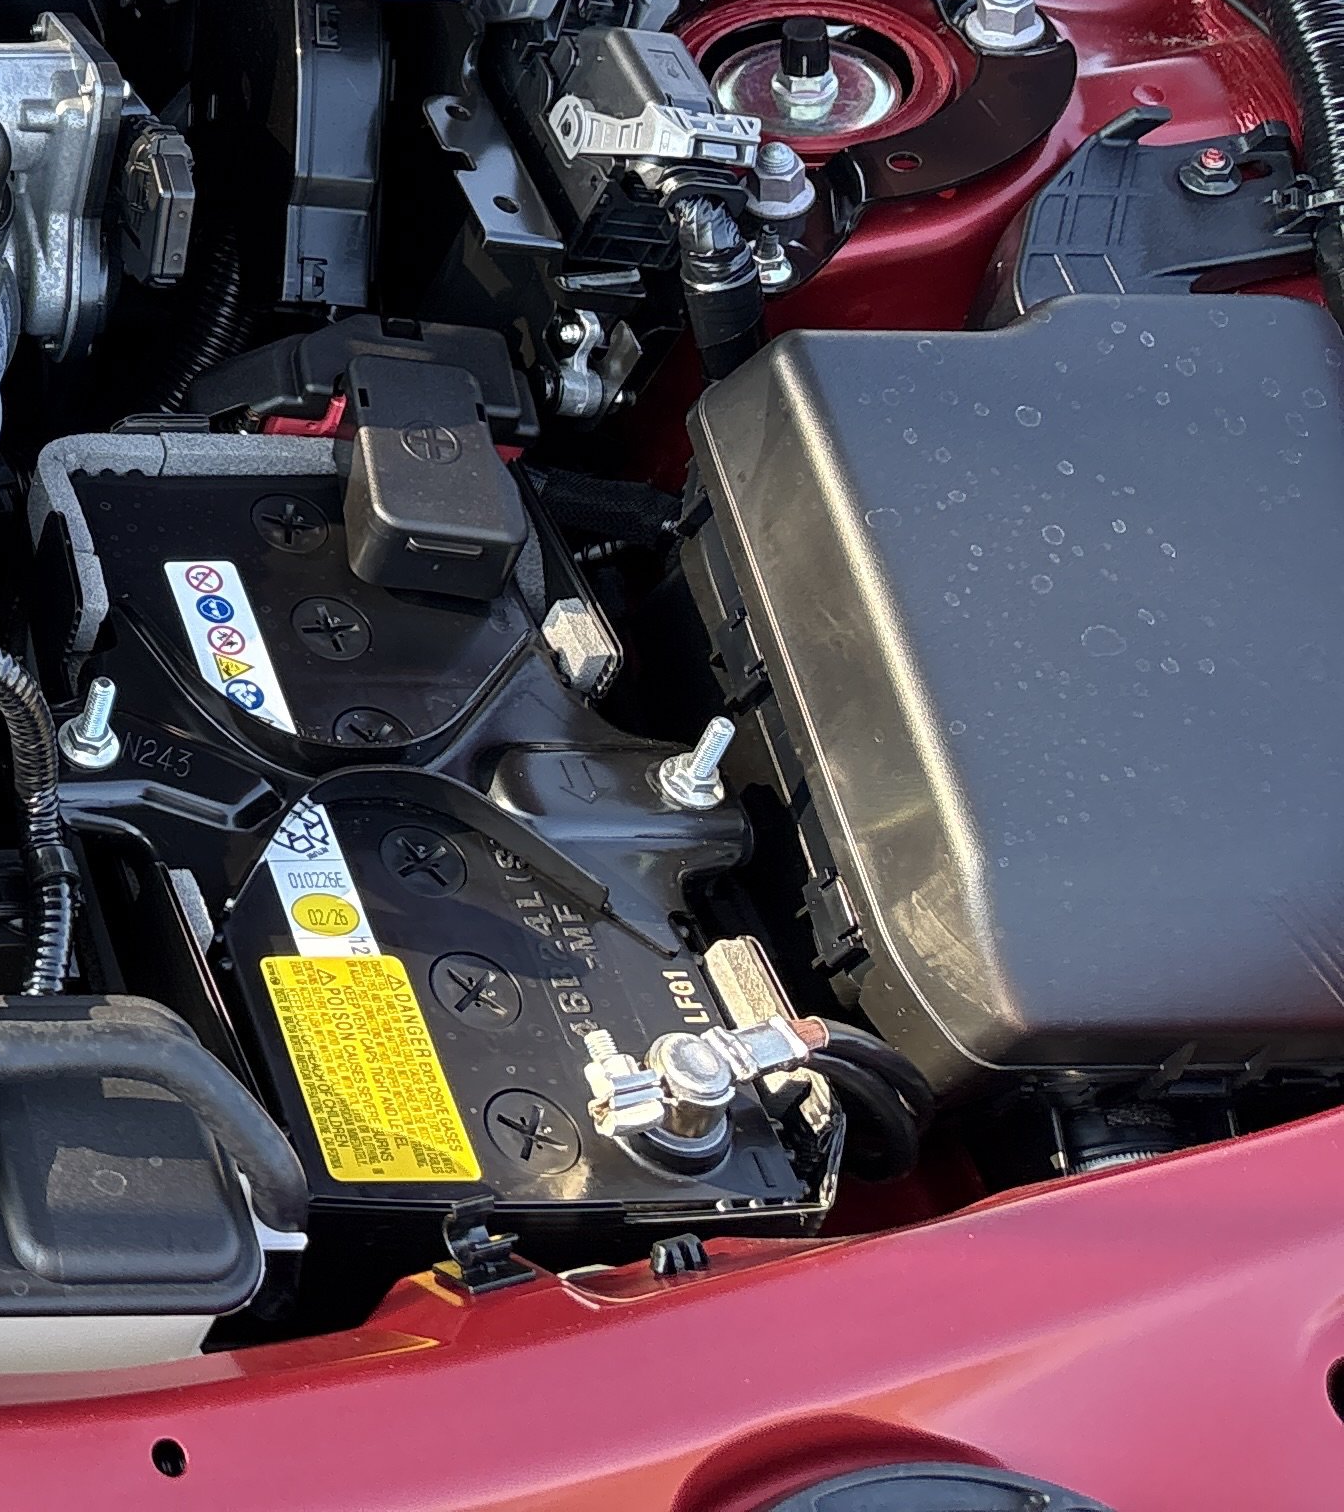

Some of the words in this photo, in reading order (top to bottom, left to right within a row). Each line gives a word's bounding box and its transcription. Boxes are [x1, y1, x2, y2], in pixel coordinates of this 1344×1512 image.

[121, 731, 194, 778] N243
[287, 871, 347, 889] 010226E
[307, 908, 349, 927] 02/26
[284, 987, 303, 1010] KEEP
[341, 985, 360, 1009] KEEP
[293, 1013, 311, 1032] OUT
[350, 1011, 369, 1034] VENT
[300, 1034, 317, 1049] OF
[359, 1038, 379, 1063] CAPS
[305, 1049, 328, 1081] REACH
[323, 987, 356, 1040] POISON
[342, 1044, 367, 1083] CAUSES
[356, 1086, 380, 1123] SEVERE
[370, 1128, 394, 1161] BURNS
[394, 992, 431, 1057] DANGER
[419, 1061, 451, 1114] EXPLOSIVE
[439, 1117, 464, 1151] GASES
[317, 1084, 333, 1098] OF
[369, 1066, 389, 1093] TIGHT
[379, 1096, 397, 1116] AND
[322, 1098, 350, 1147] CHILDREN
[387, 1119, 409, 1149] LEVEL
